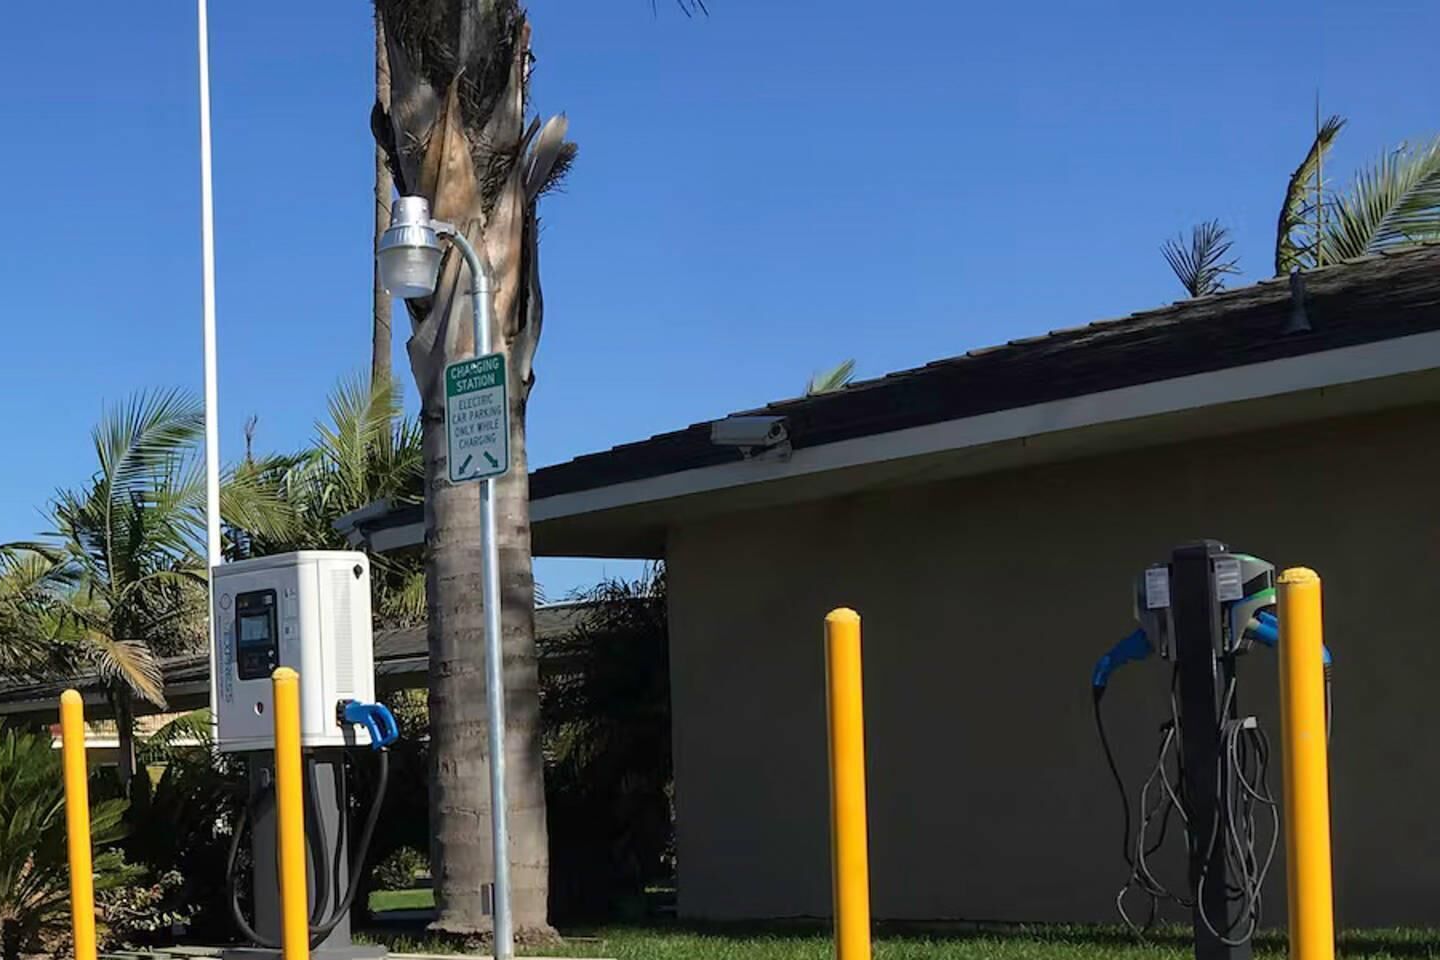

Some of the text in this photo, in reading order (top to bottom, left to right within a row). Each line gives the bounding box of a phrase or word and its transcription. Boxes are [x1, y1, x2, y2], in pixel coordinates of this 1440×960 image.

[451, 358, 499, 380] CHARGING
[456, 374, 495, 393] STATION
[458, 393, 494, 410] ELECTRIC
[452, 406, 502, 424] CAR PARKING
[454, 420, 500, 438] ONLY WHILE
[458, 433, 497, 450] CHARGING
